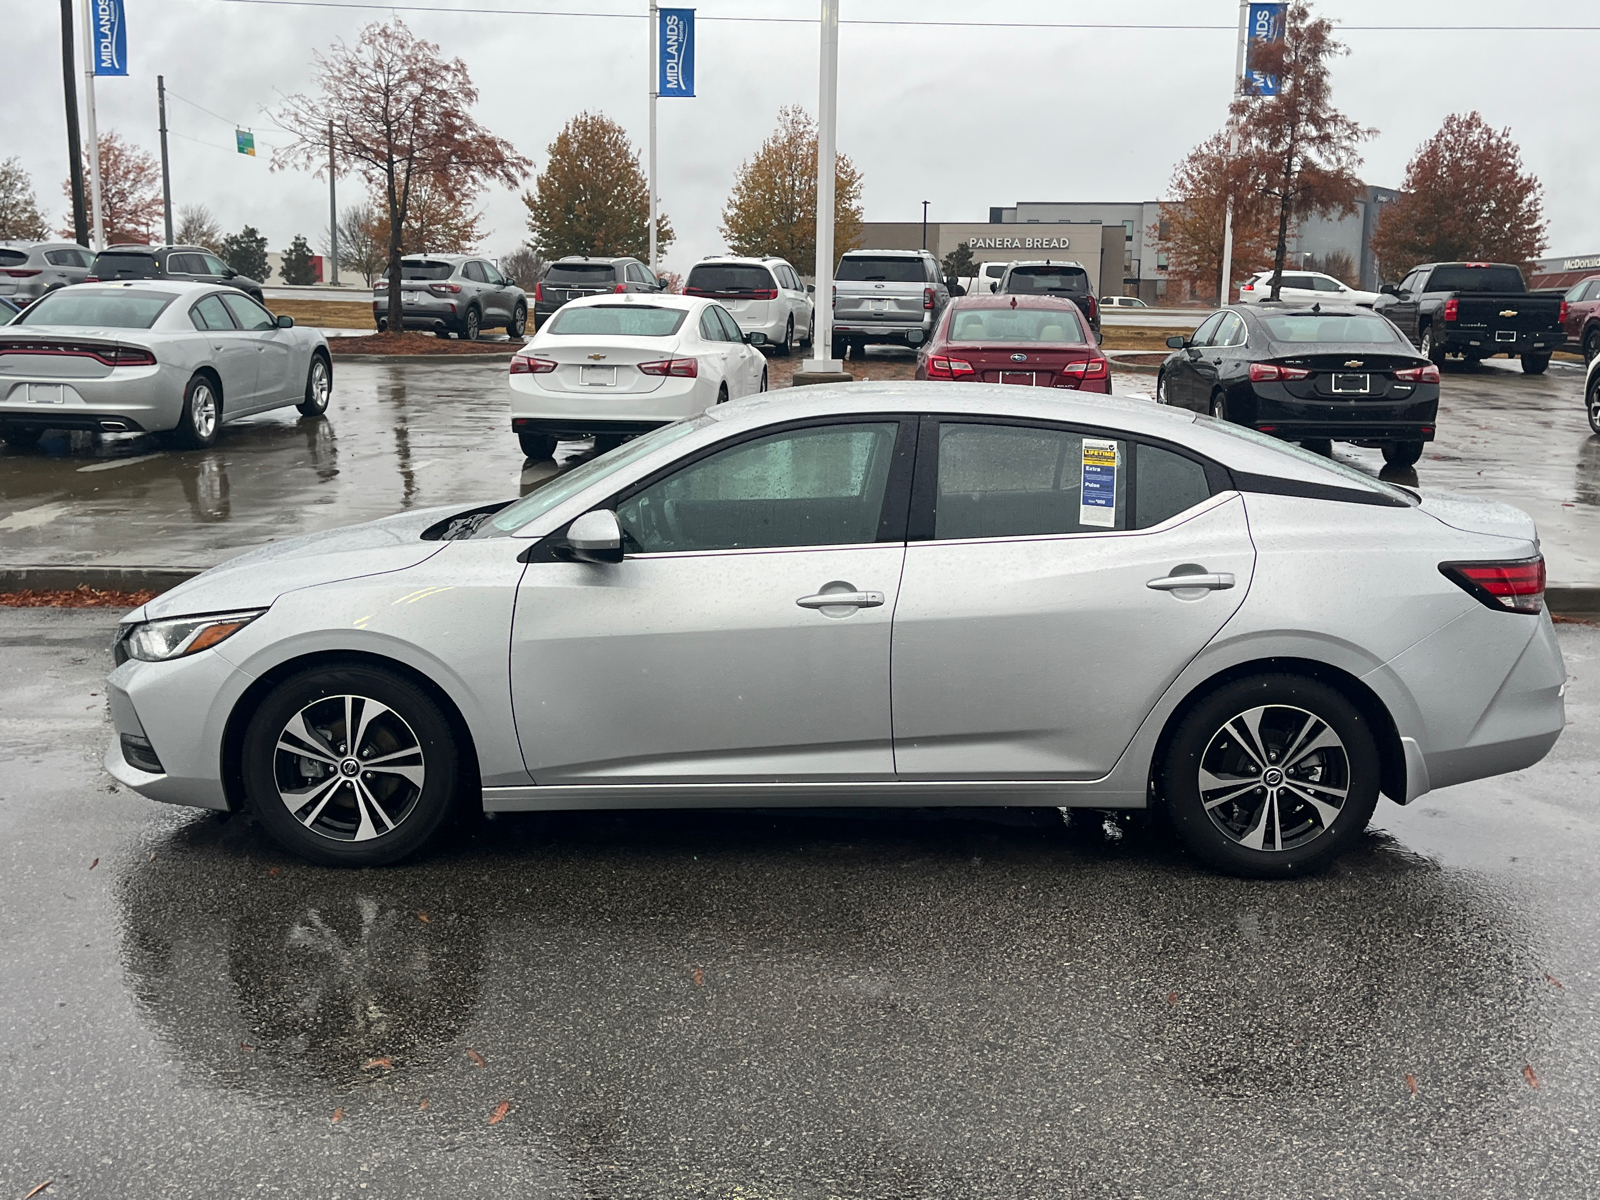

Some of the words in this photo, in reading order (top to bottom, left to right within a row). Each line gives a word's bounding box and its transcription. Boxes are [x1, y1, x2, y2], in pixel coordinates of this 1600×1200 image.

[666, 15, 678, 88] MIDLANDS
[969, 237, 1021, 249] PANERA
[1025, 237, 1069, 249] BREAD
[1084, 449, 1115, 457] LIFETIME
